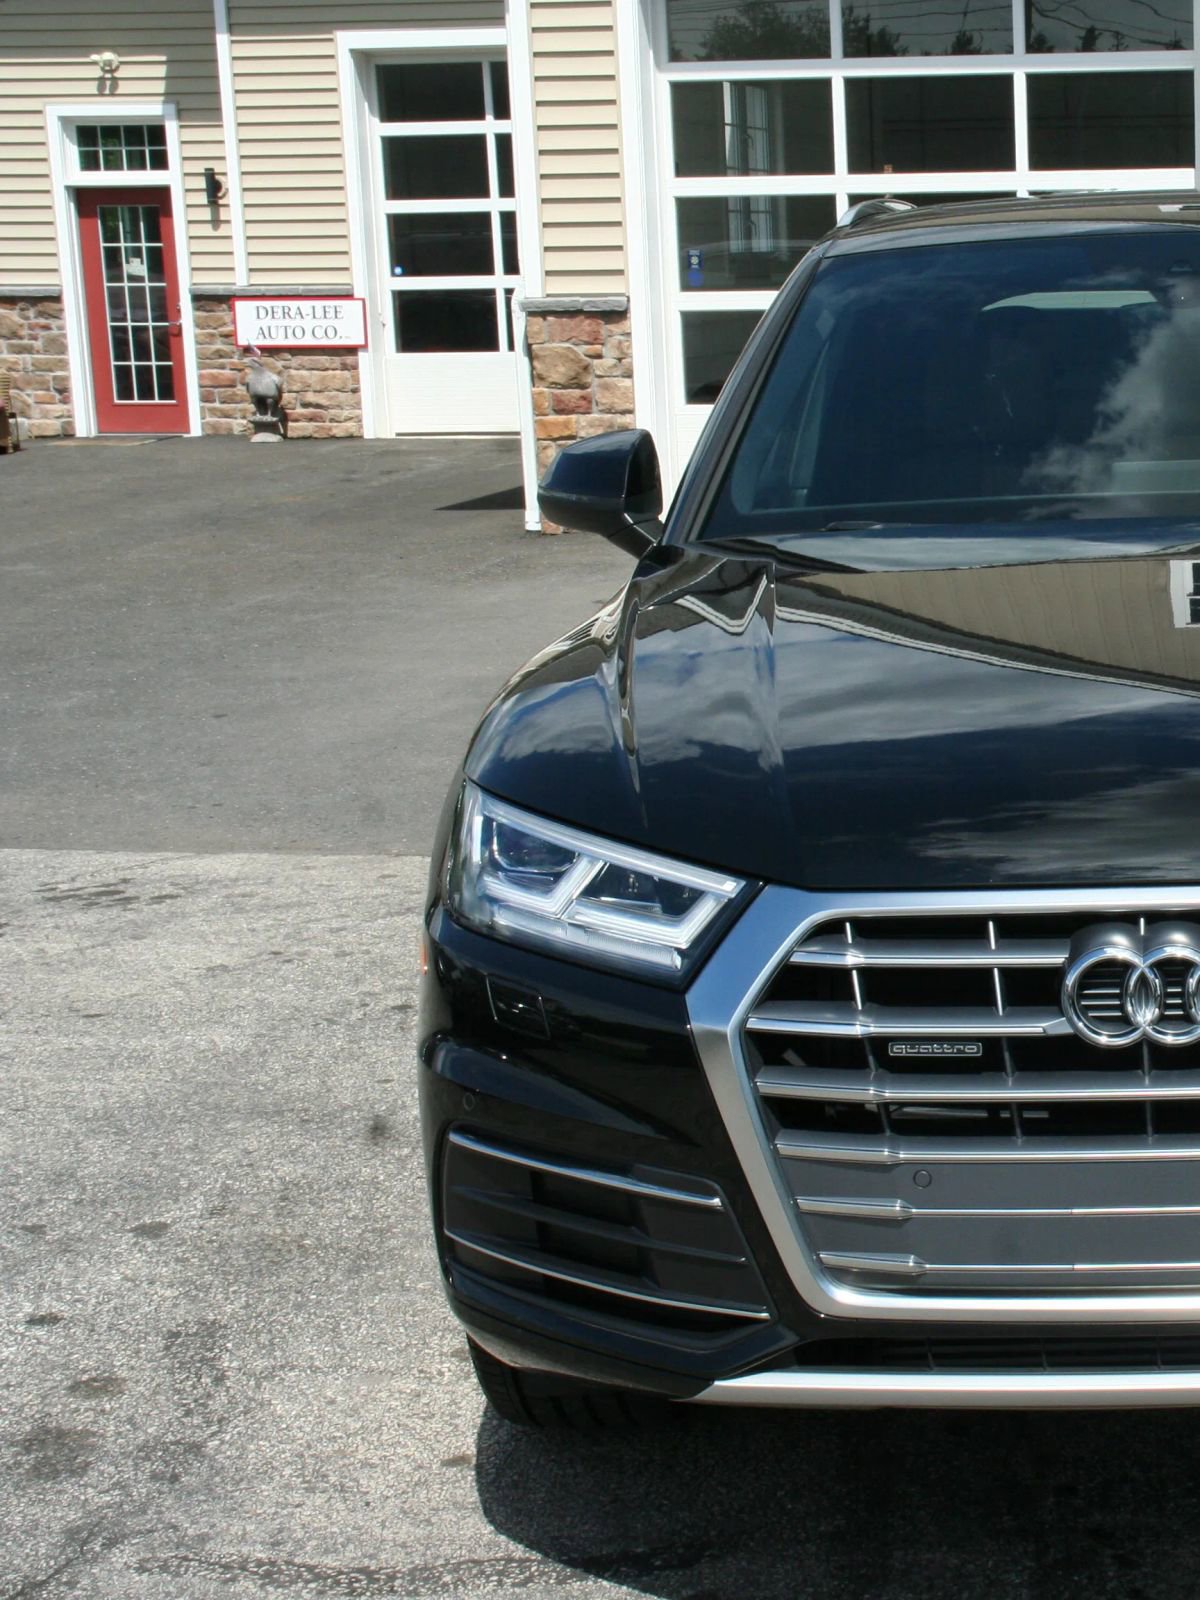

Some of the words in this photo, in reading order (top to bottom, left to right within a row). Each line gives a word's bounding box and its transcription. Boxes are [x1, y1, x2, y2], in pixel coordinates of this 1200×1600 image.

[255, 304, 344, 320] DERA-LEE
[255, 324, 306, 340] AUTO
[311, 324, 343, 340] CO.
[893, 1045, 978, 1054] quattro
